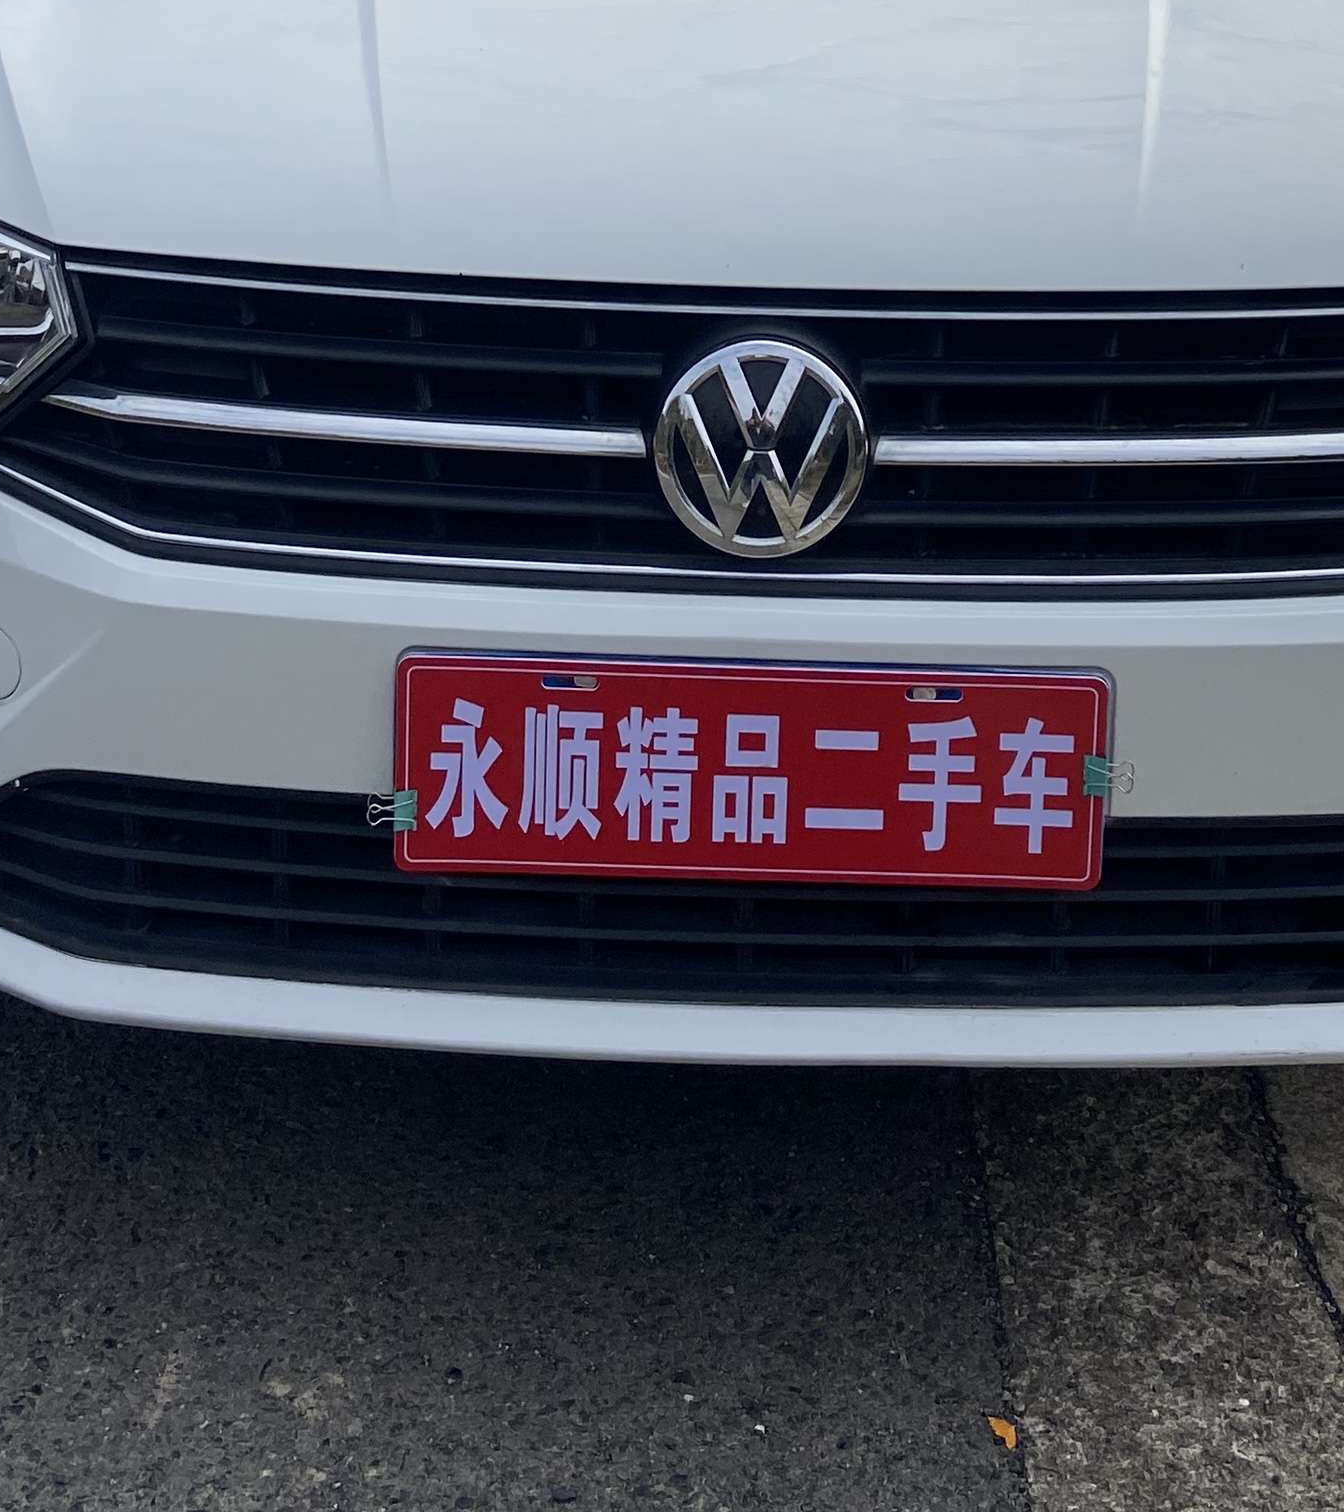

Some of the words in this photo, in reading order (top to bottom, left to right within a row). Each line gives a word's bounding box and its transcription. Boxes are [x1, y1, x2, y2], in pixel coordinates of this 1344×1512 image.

[425, 698, 1075, 854] 永顺精品二手车
